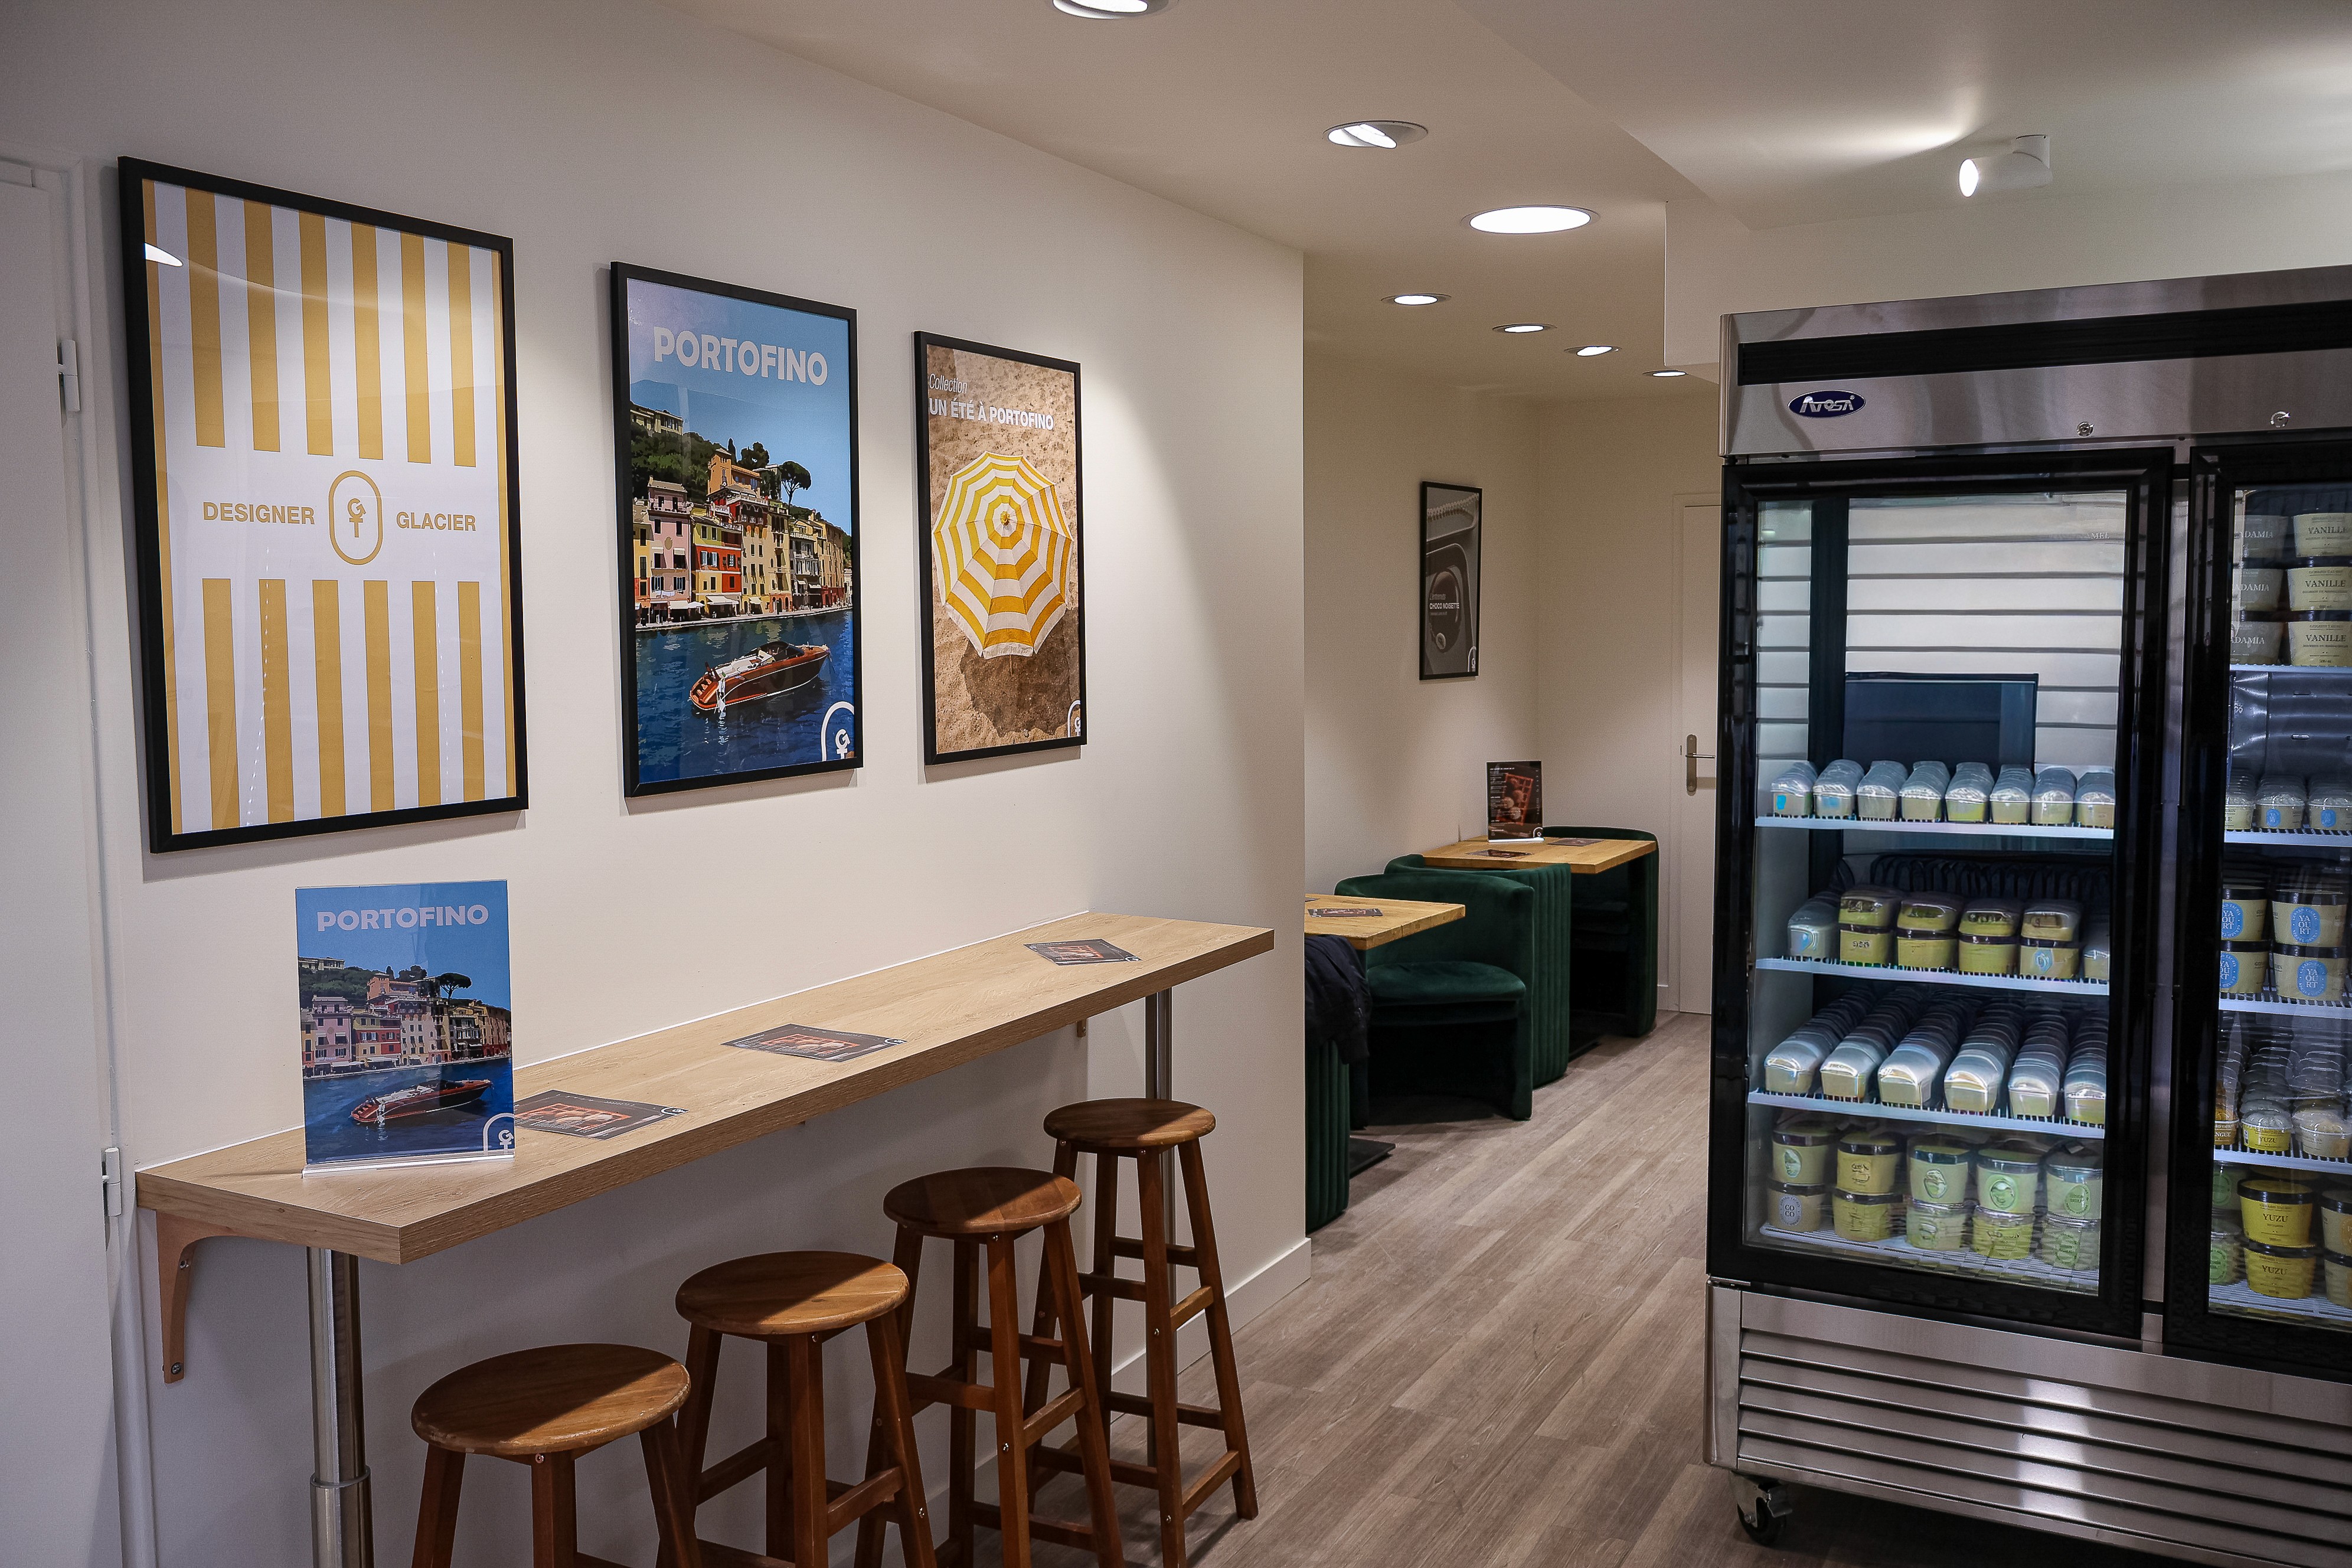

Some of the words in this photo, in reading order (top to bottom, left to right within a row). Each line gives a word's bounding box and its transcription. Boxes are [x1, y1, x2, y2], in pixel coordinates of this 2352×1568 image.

[654, 326, 828, 386] PORTOFINO
[929, 373, 968, 394] Collection
[929, 397, 947, 417] UN
[950, 397, 975, 420] ÉTÉ
[978, 401, 987, 422] À
[989, 407, 1054, 430] PORTOFINO
[202, 501, 315, 525] DESIGNER
[396, 511, 476, 532] GLACIER
[2308, 526, 2347, 534] VANILLE
[2305, 634, 2347, 642] VANILLE
[316, 904, 489, 932] PORTOFINO
[2263, 1213, 2289, 1223] YUZU
[2262, 1265, 2288, 1275] YUZU
